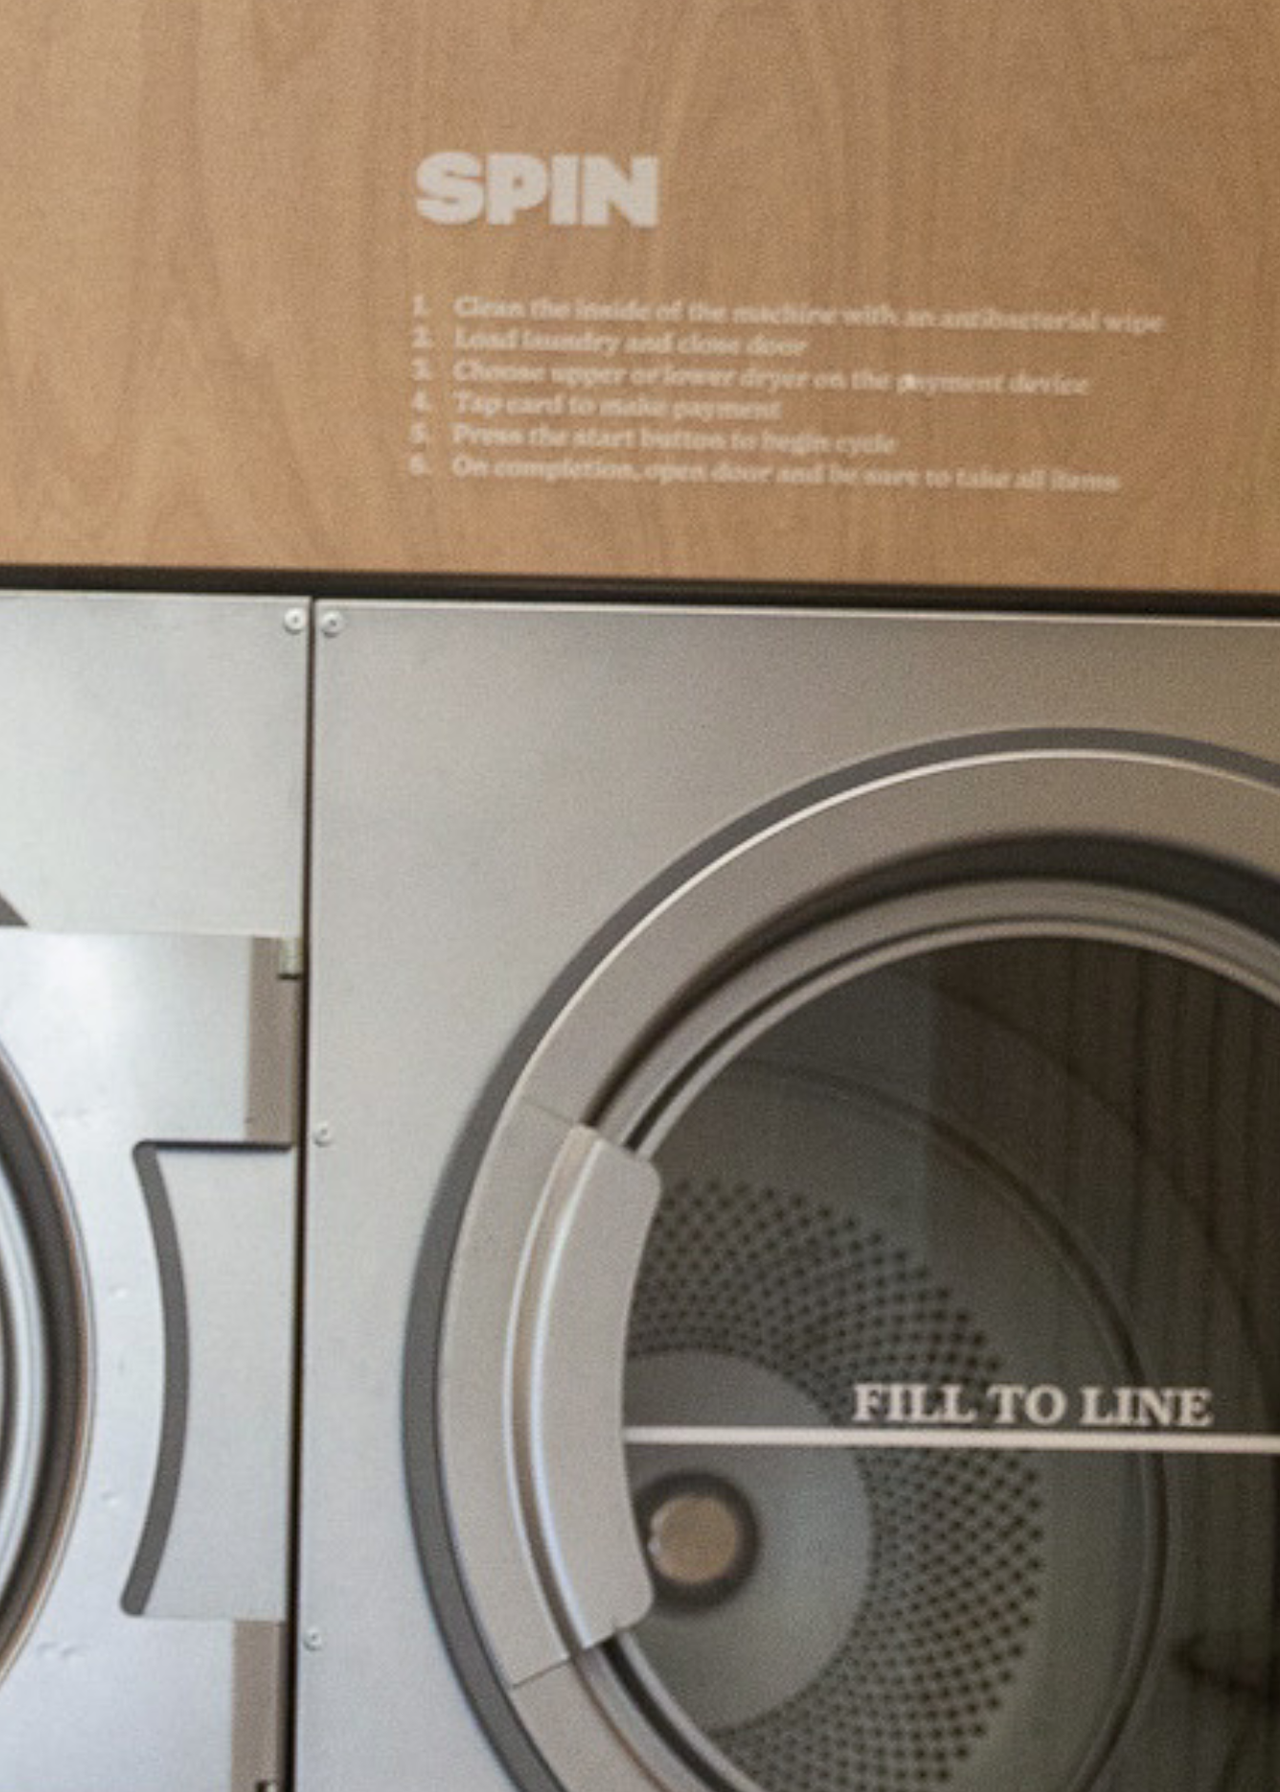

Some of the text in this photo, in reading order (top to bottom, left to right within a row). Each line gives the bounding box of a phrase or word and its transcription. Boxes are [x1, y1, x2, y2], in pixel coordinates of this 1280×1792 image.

[416, 151, 658, 228] SPIN
[853, 1382, 1214, 1429] FILL TO LINE
